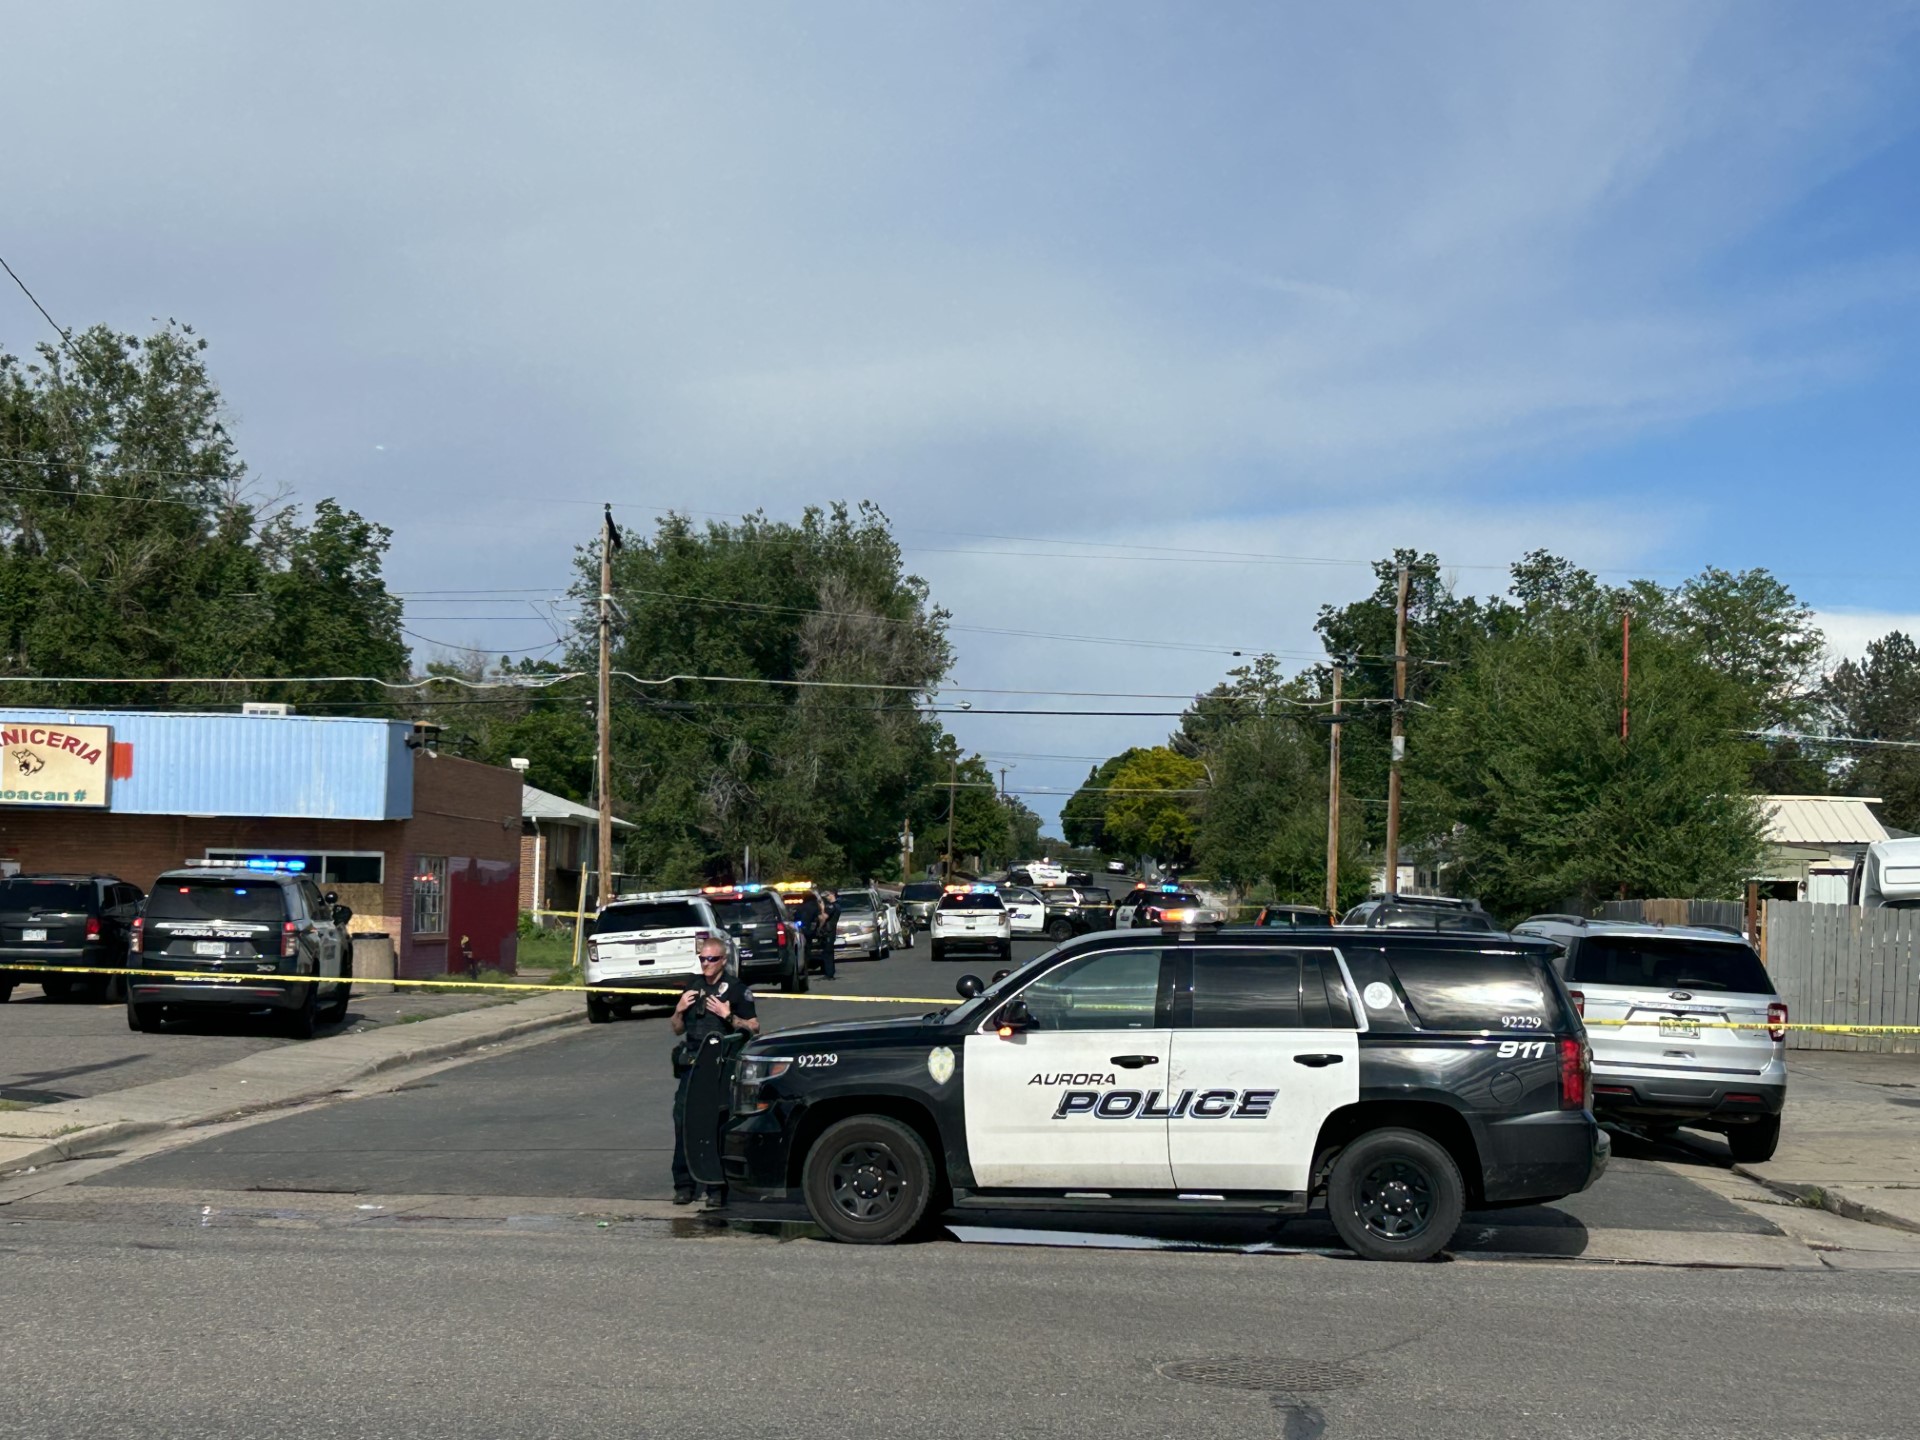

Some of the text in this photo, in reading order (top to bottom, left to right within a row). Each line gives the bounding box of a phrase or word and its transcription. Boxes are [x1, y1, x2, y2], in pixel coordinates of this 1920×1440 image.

[0, 729, 102, 765] NICERIA
[0, 790, 69, 801] oacan
[1501, 1015, 1542, 1029] 92229
[1497, 1041, 1547, 1059] 911
[798, 1053, 838, 1068] 92229
[1028, 1073, 1117, 1085] AURORA
[1051, 1089, 1280, 1119] POLICE
